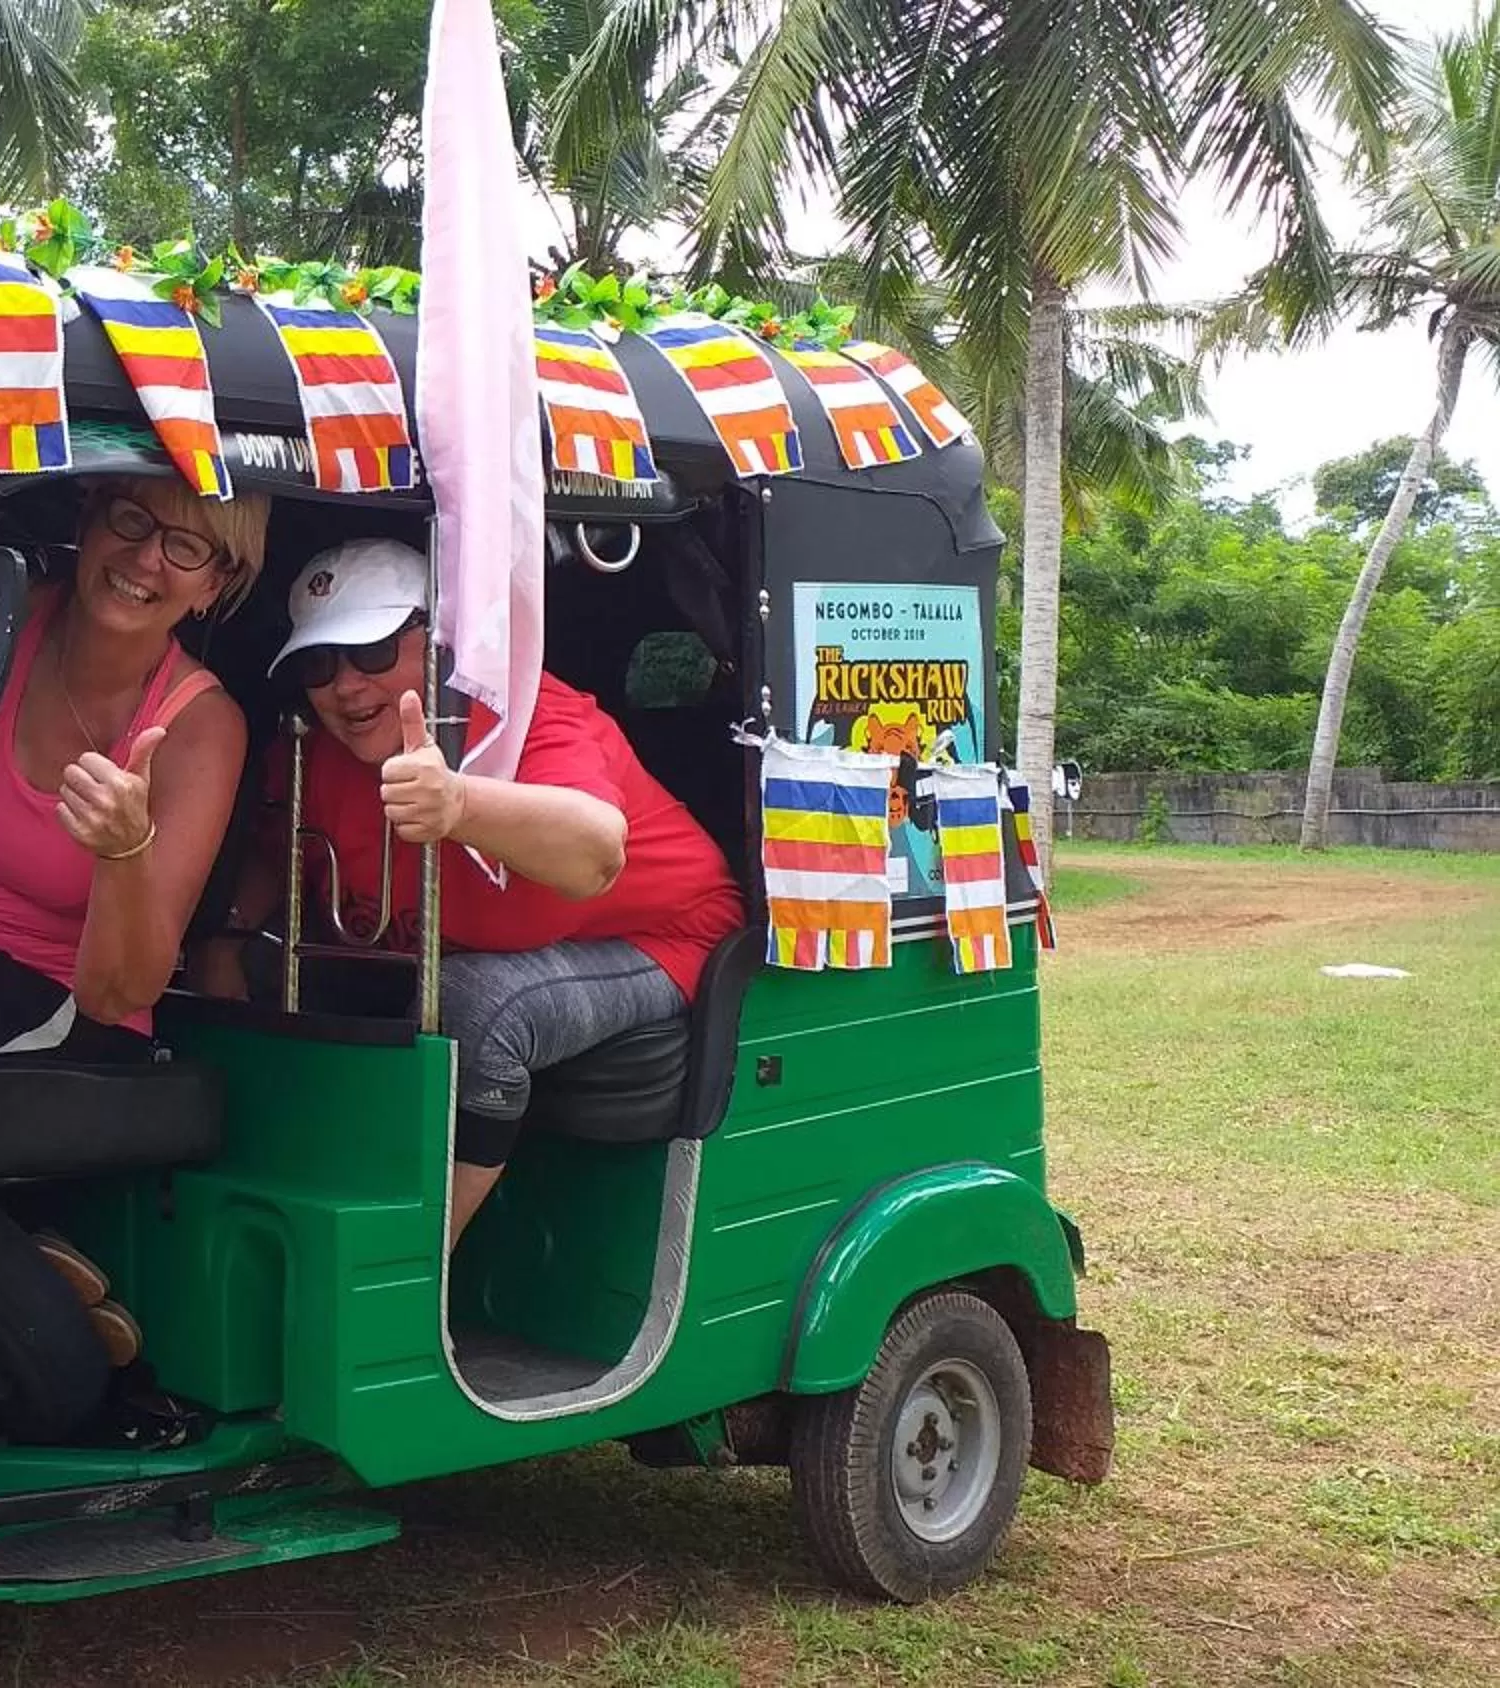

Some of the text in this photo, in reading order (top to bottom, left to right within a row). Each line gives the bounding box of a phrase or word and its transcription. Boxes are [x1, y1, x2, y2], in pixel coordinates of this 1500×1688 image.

[235, 433, 288, 470] DON'T
[815, 602, 893, 620] NEGOMBO
[913, 603, 963, 621] TALALLA
[851, 627, 900, 641] OCTOBER
[815, 647, 843, 662] THE
[817, 661, 968, 701] RICKSHAW
[926, 699, 966, 723] RUN
